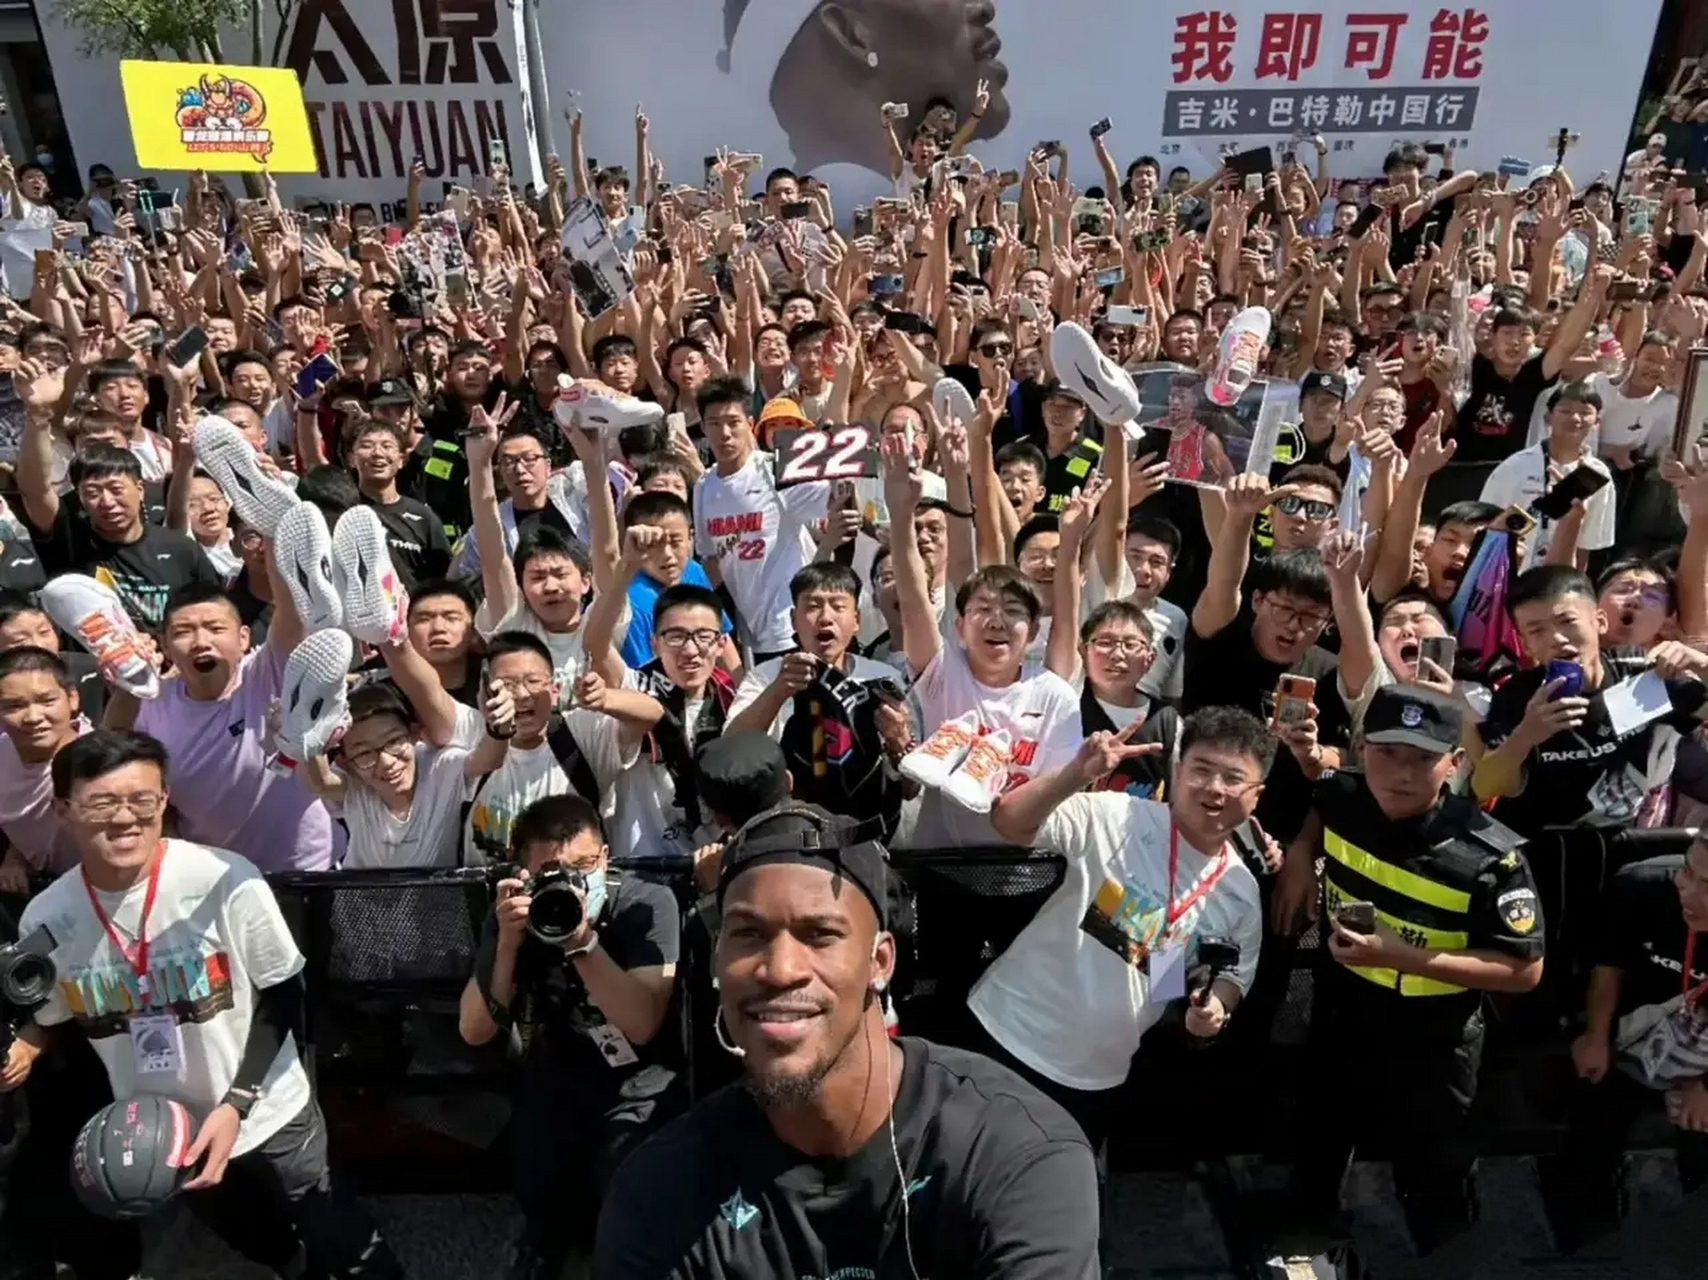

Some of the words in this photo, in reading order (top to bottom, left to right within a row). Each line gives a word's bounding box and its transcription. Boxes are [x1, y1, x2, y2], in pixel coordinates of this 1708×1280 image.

[1171, 9, 1490, 83] 我即可能
[1177, 94, 1464, 129] 吉米·巴特勒中国行
[305, 99, 513, 178] TAIYUAN
[778, 425, 872, 484] 22
[737, 538, 767, 561] 22
[1541, 750, 1589, 763] TAKE
[1591, 742, 1618, 758] US
